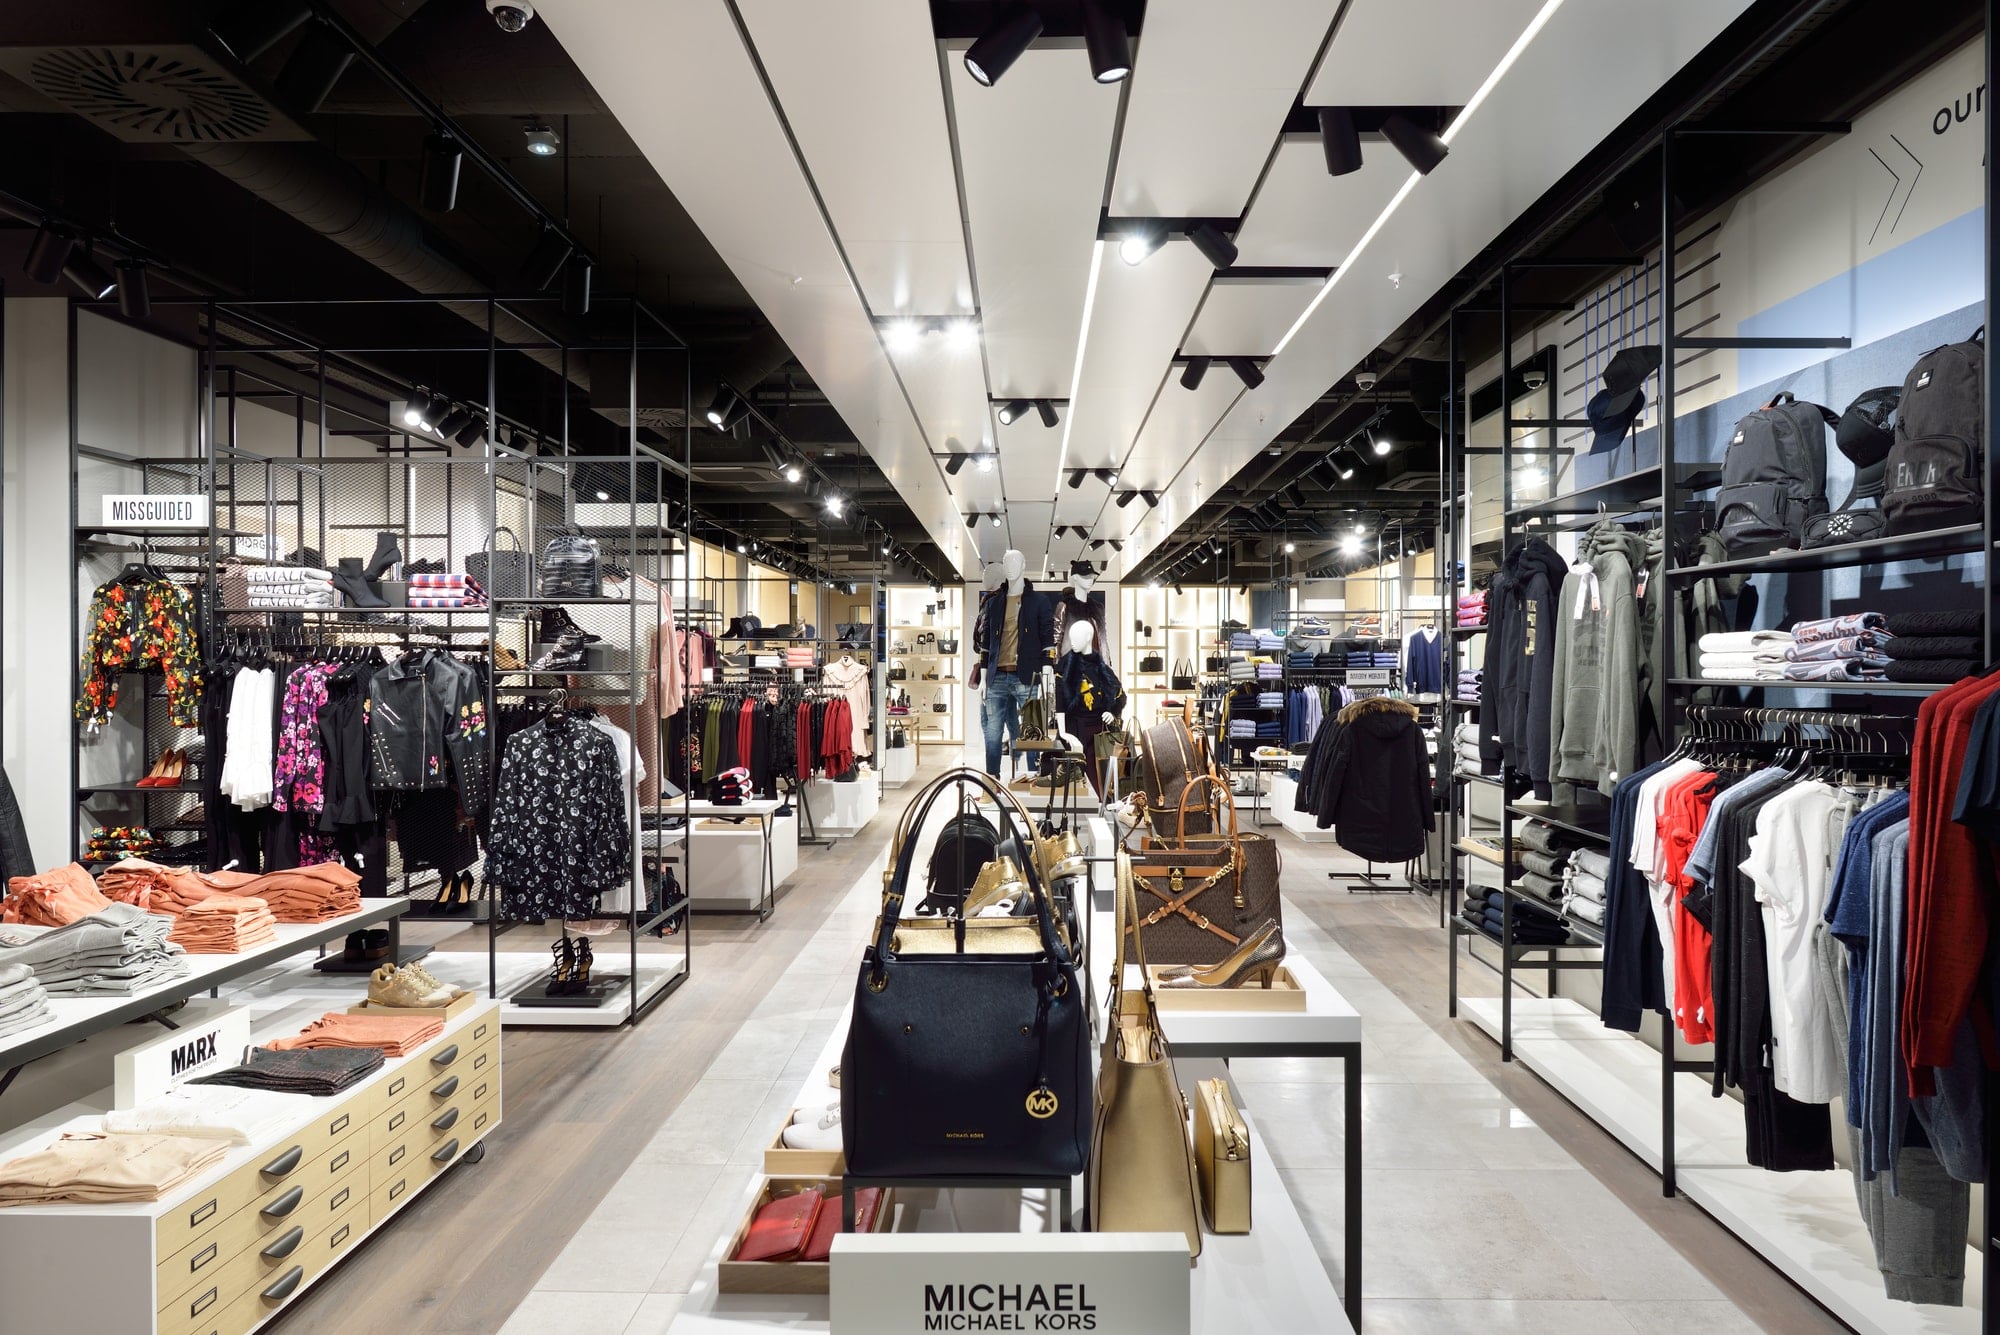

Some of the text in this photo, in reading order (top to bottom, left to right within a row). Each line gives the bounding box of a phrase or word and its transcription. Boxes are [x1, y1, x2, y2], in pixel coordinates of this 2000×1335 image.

[112, 501, 192, 521] MISSGUIDED
[172, 1031, 216, 1076] MARX
[925, 1284, 1096, 1311] MICHAEL
[925, 1314, 1096, 1330] MICHAEL KORS
